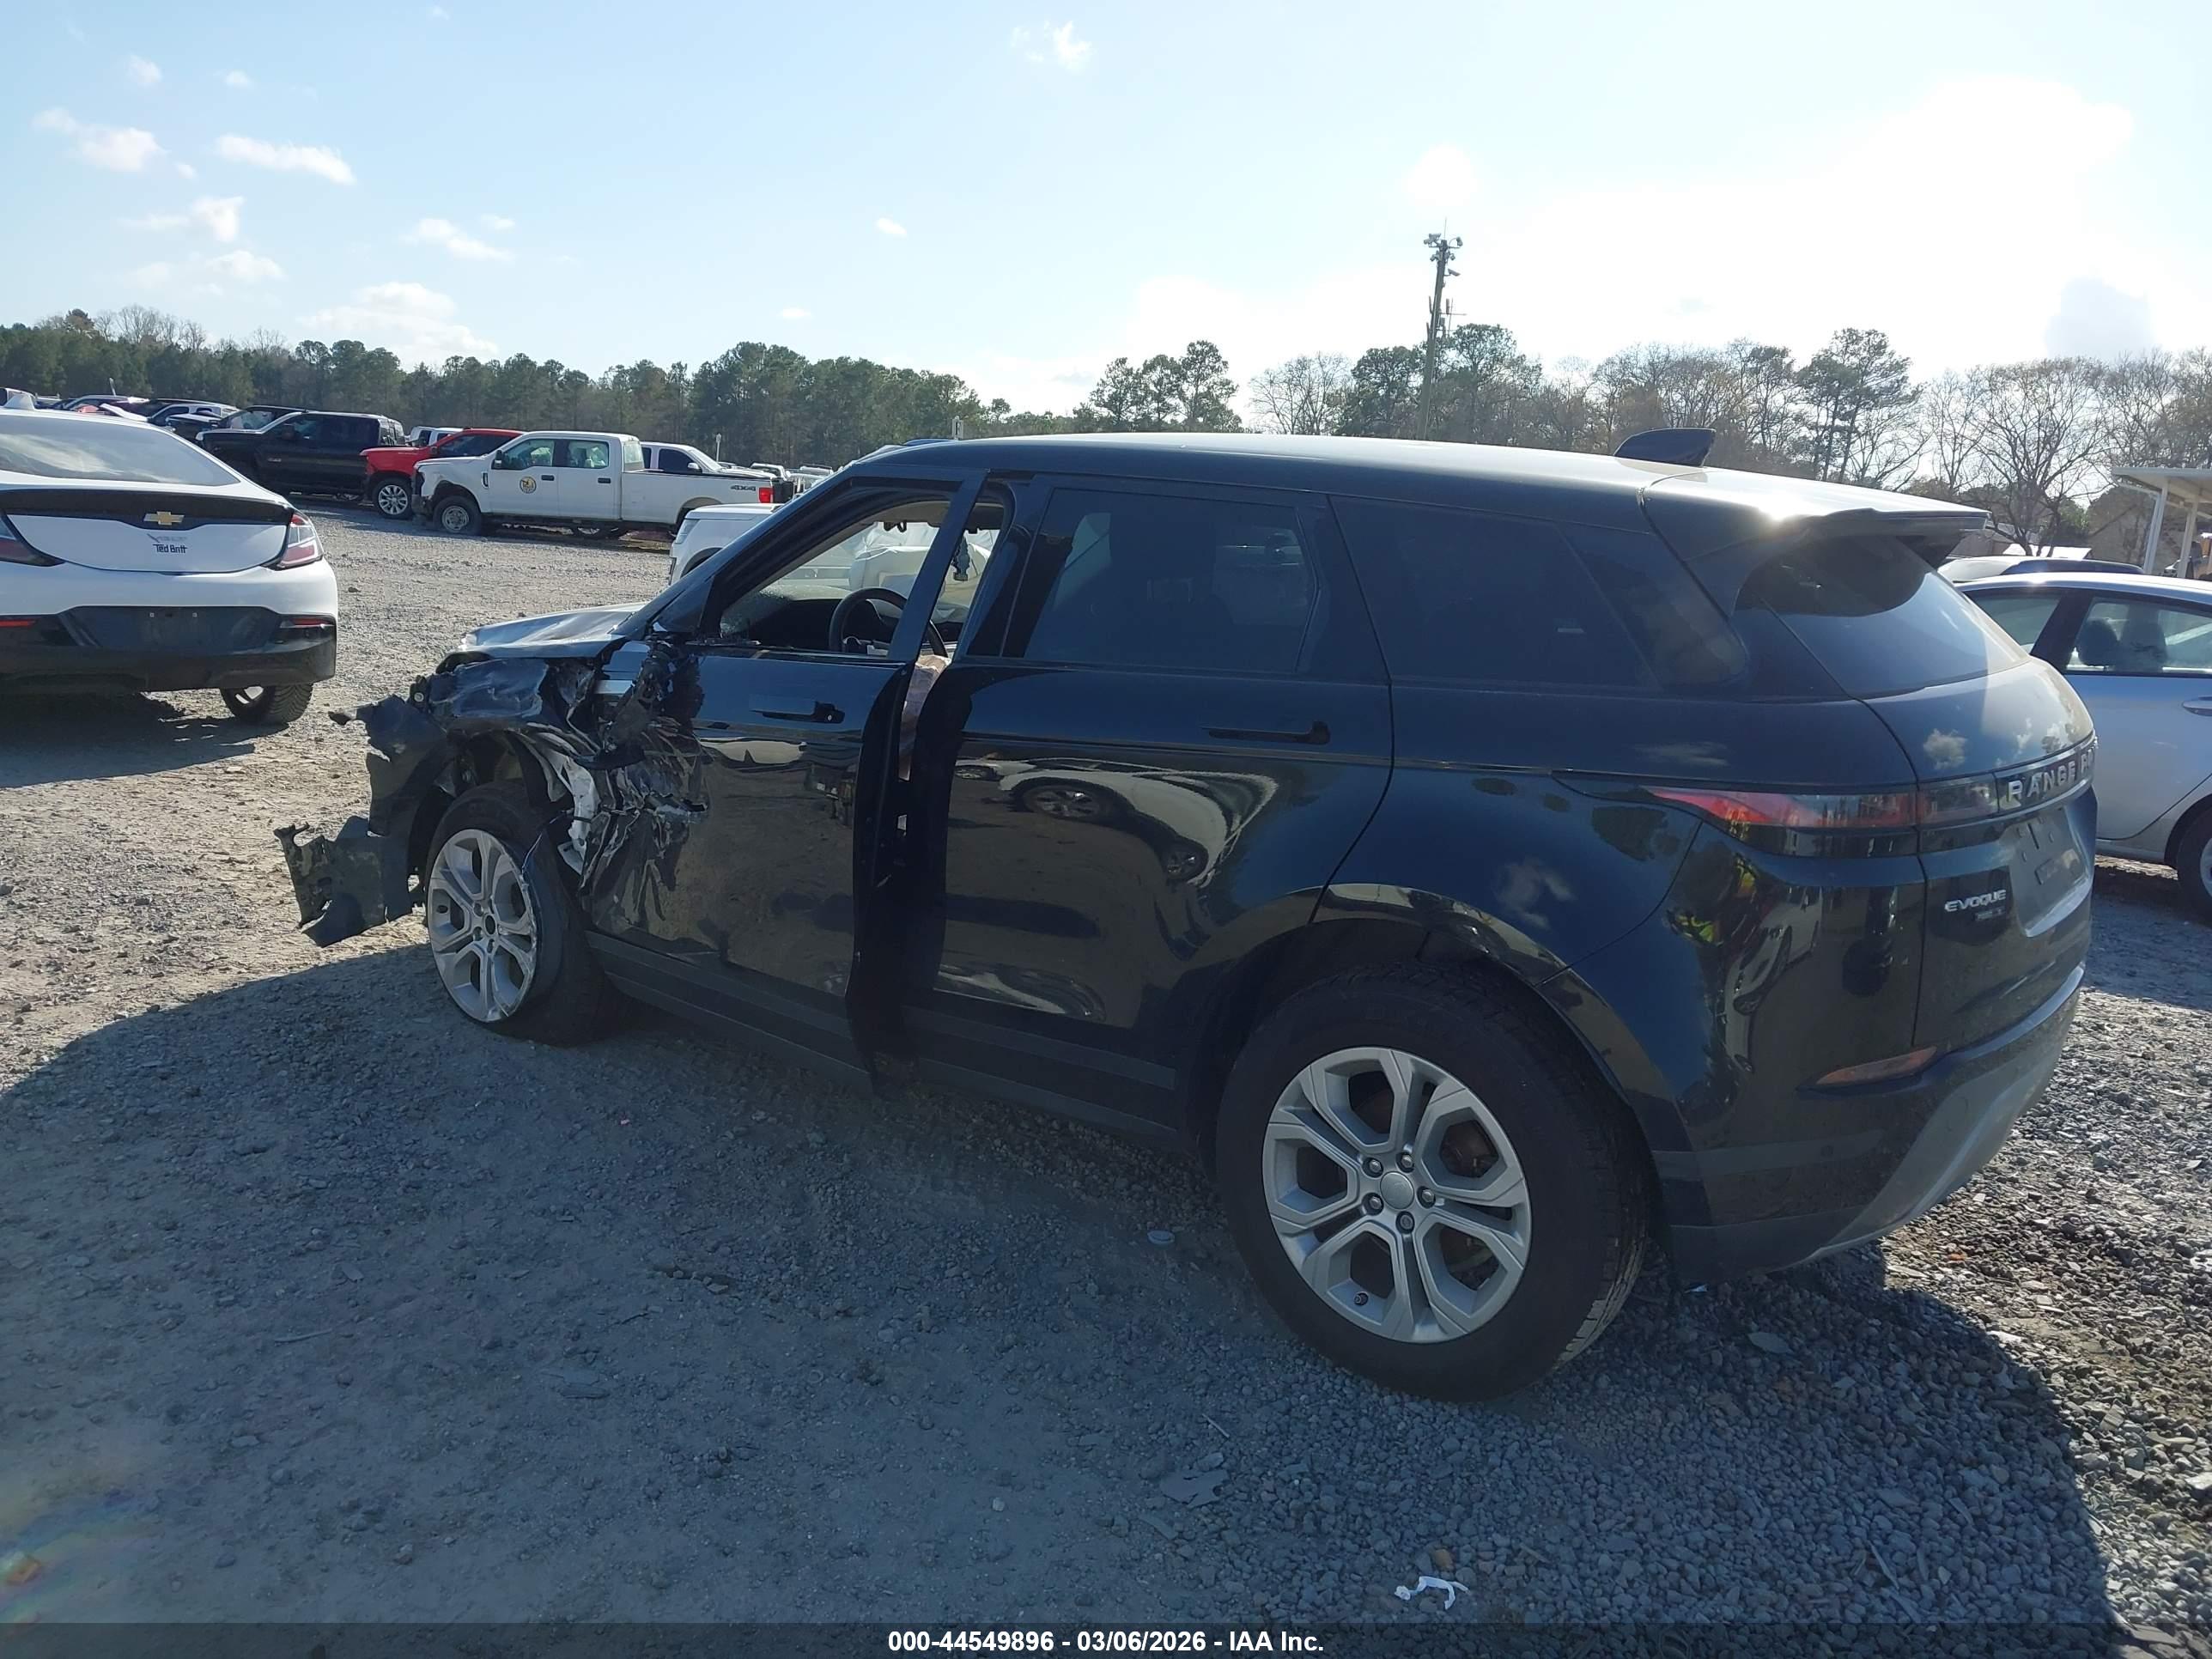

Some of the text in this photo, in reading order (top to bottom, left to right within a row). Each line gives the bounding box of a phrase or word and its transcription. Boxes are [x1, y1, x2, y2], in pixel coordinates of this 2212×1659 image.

[153, 544, 188, 554] Ted Britt
[2006, 761, 2076, 802] RANGE
[1944, 889, 2007, 912] EVOQUE
